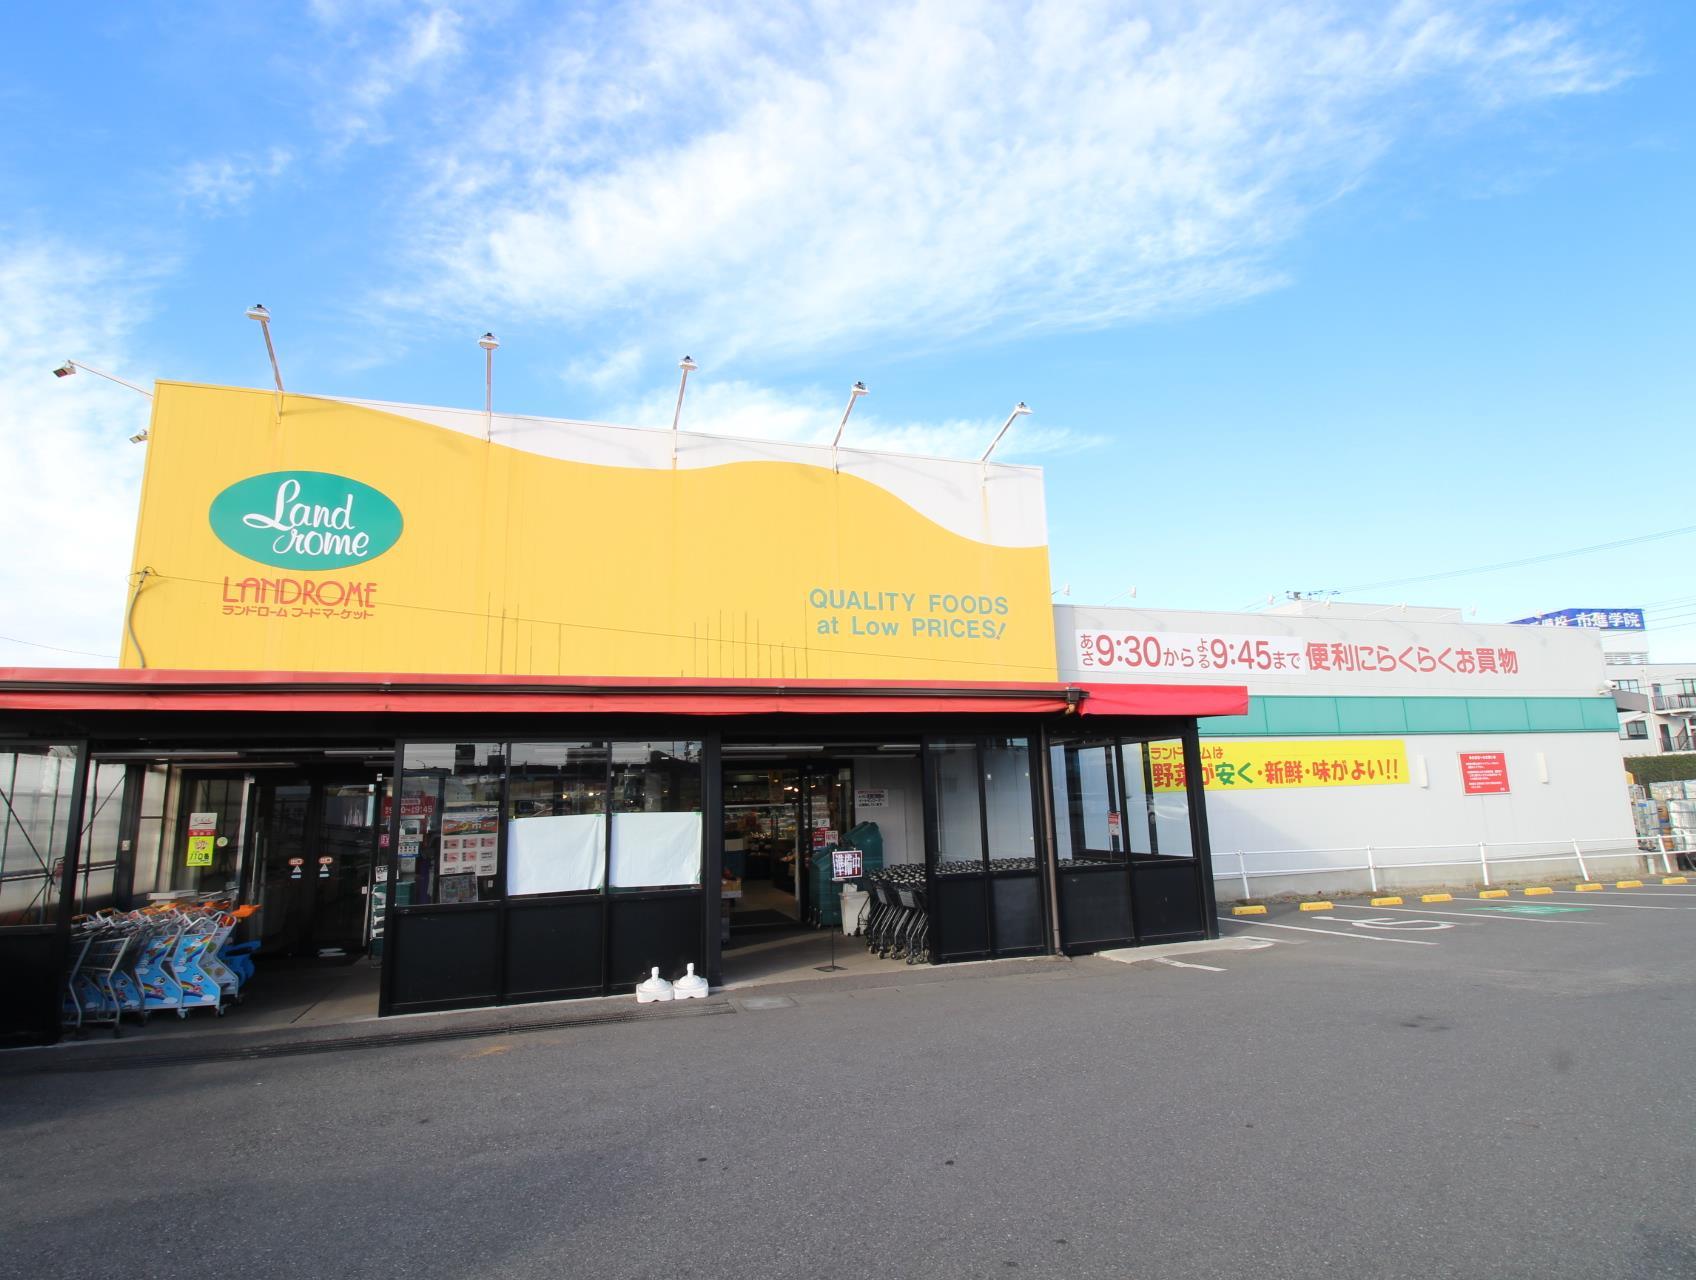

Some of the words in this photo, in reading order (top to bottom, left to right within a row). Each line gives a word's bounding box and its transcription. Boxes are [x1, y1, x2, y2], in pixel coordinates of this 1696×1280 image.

[243, 479, 356, 531] Land
[272, 528, 369, 557] rome
[222, 576, 378, 608] LANDROME
[809, 588, 916, 612] QUALITY
[928, 594, 1009, 616] FOODS
[222, 605, 287, 618] ランドローム
[291, 607, 374, 620] フードマーケット
[816, 616, 840, 635] at
[851, 616, 899, 636] Low
[911, 618, 1007, 640] PRICES!
[1305, 642, 1519, 674] 便利にらくらくお買物
[1150, 746, 1224, 760] ランドムは
